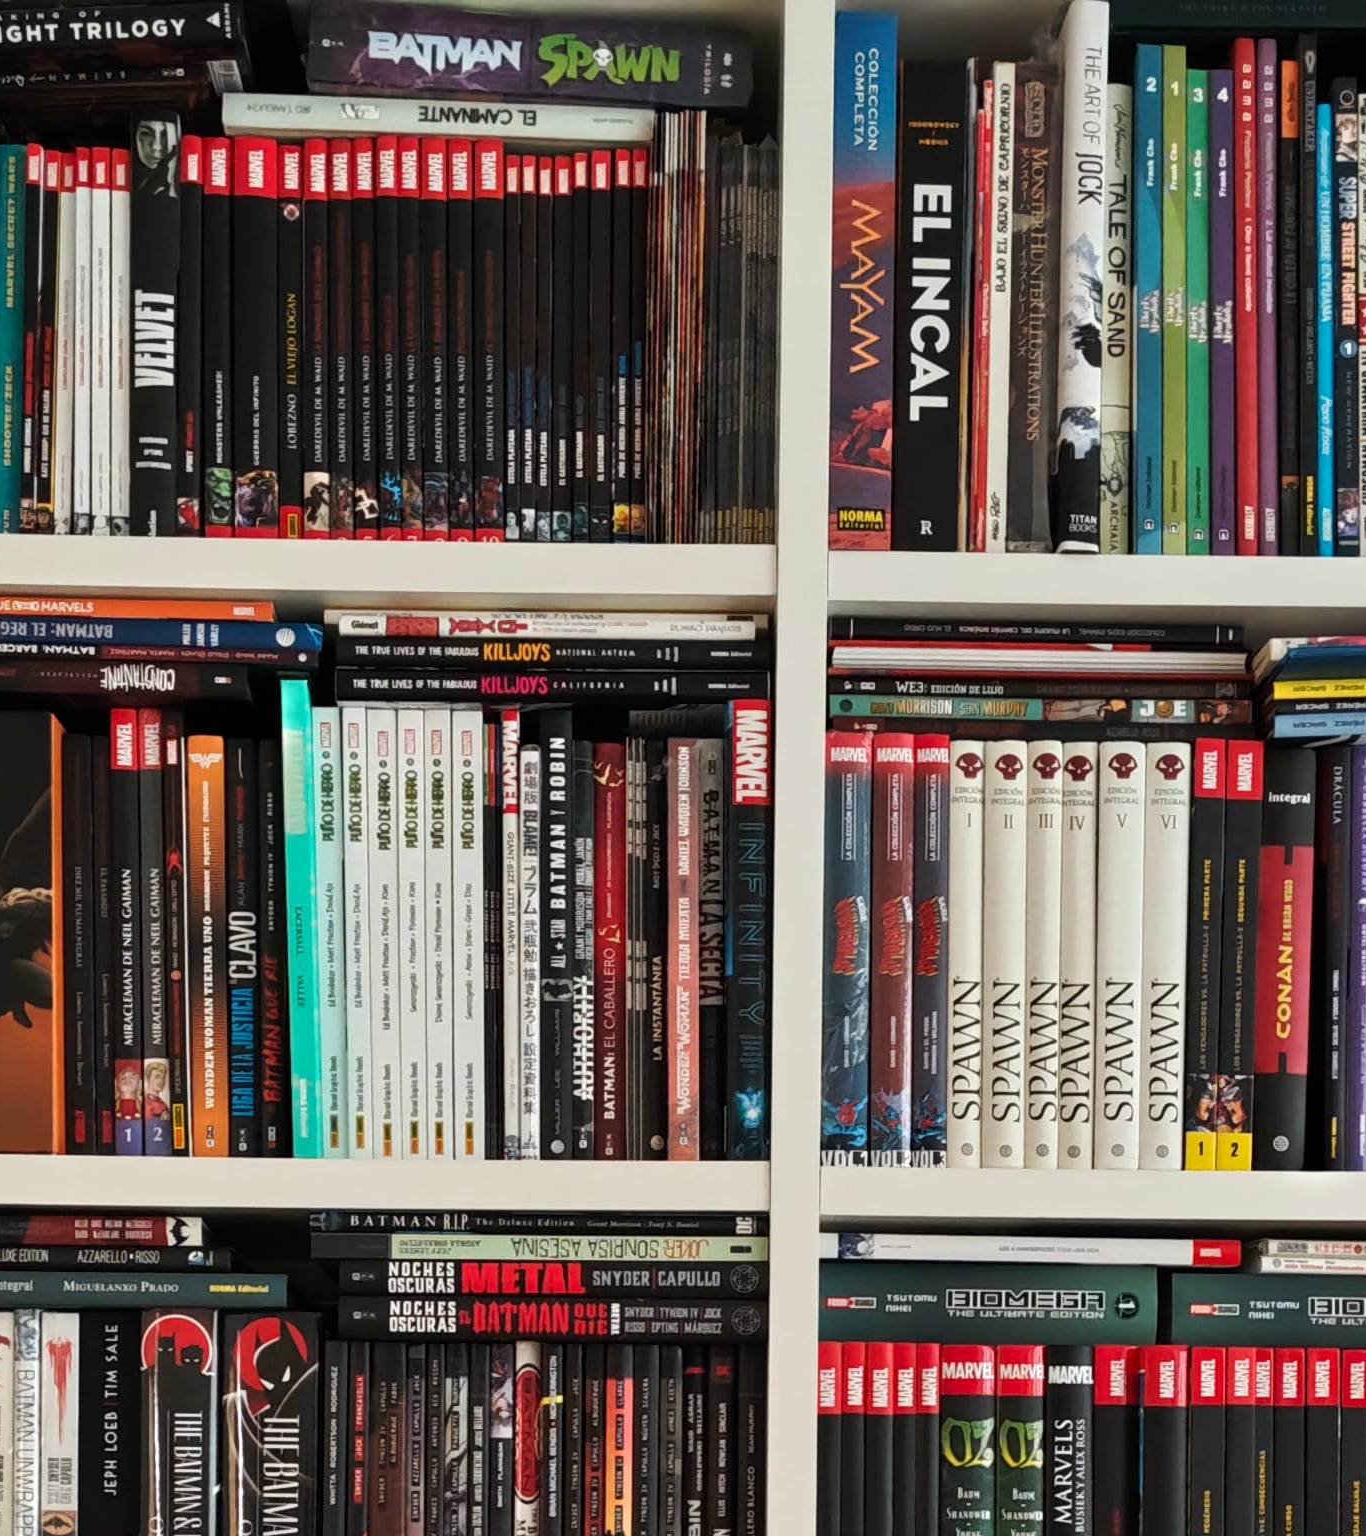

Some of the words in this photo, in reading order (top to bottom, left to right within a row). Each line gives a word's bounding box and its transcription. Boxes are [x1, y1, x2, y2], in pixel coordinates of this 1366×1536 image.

[71, 19, 187, 41] TRILOGY
[368, 30, 523, 76] BATMAN
[538, 33, 680, 86] SPAWN
[853, 51, 865, 147] COMPLETA
[867, 47, 879, 151] COLECCIÓN
[418, 105, 513, 125] CAMINANTE
[523, 109, 537, 126] EL
[912, 183, 952, 243] EL
[1107, 174, 1127, 239] TALE
[1108, 245, 1126, 276] OF
[1106, 289, 1126, 359] SAND
[134, 289, 175, 387] VELVET
[909, 258, 952, 422] INCAL
[839, 509, 883, 523] NORMA
[1069, 524, 1098, 533] BOOKS
[1070, 514, 1098, 524] TITAN
[353, 679, 367, 689] THE
[370, 679, 388, 689] TRUE
[391, 679, 413, 689] LIVES
[416, 680, 424, 689] OF
[427, 680, 440, 689] THE
[443, 679, 477, 690] FABULOUS
[481, 676, 548, 695] KILLJOYS
[735, 707, 768, 803] MARVEL
[1269, 791, 1311, 805] integral
[1276, 944, 1293, 1039] CONAN
[952, 978, 982, 1124] SPAWN
[388, 1261, 455, 1277] NOCHES
[462, 1262, 585, 1294] METAL
[592, 1270, 650, 1288] SNYDER
[658, 1270, 721, 1287] CAPULLO
[388, 1277, 455, 1293] OSCURAS
[947, 1308, 975, 1319] THE
[980, 1308, 1045, 1319] ULTIMATE
[1049, 1308, 1105, 1319] EDITION
[942, 1361, 993, 1380] MARVEL
[173, 1409, 204, 1443] THE
[173, 1446, 204, 1510] BATMAN
[173, 1516, 203, 1530] &
